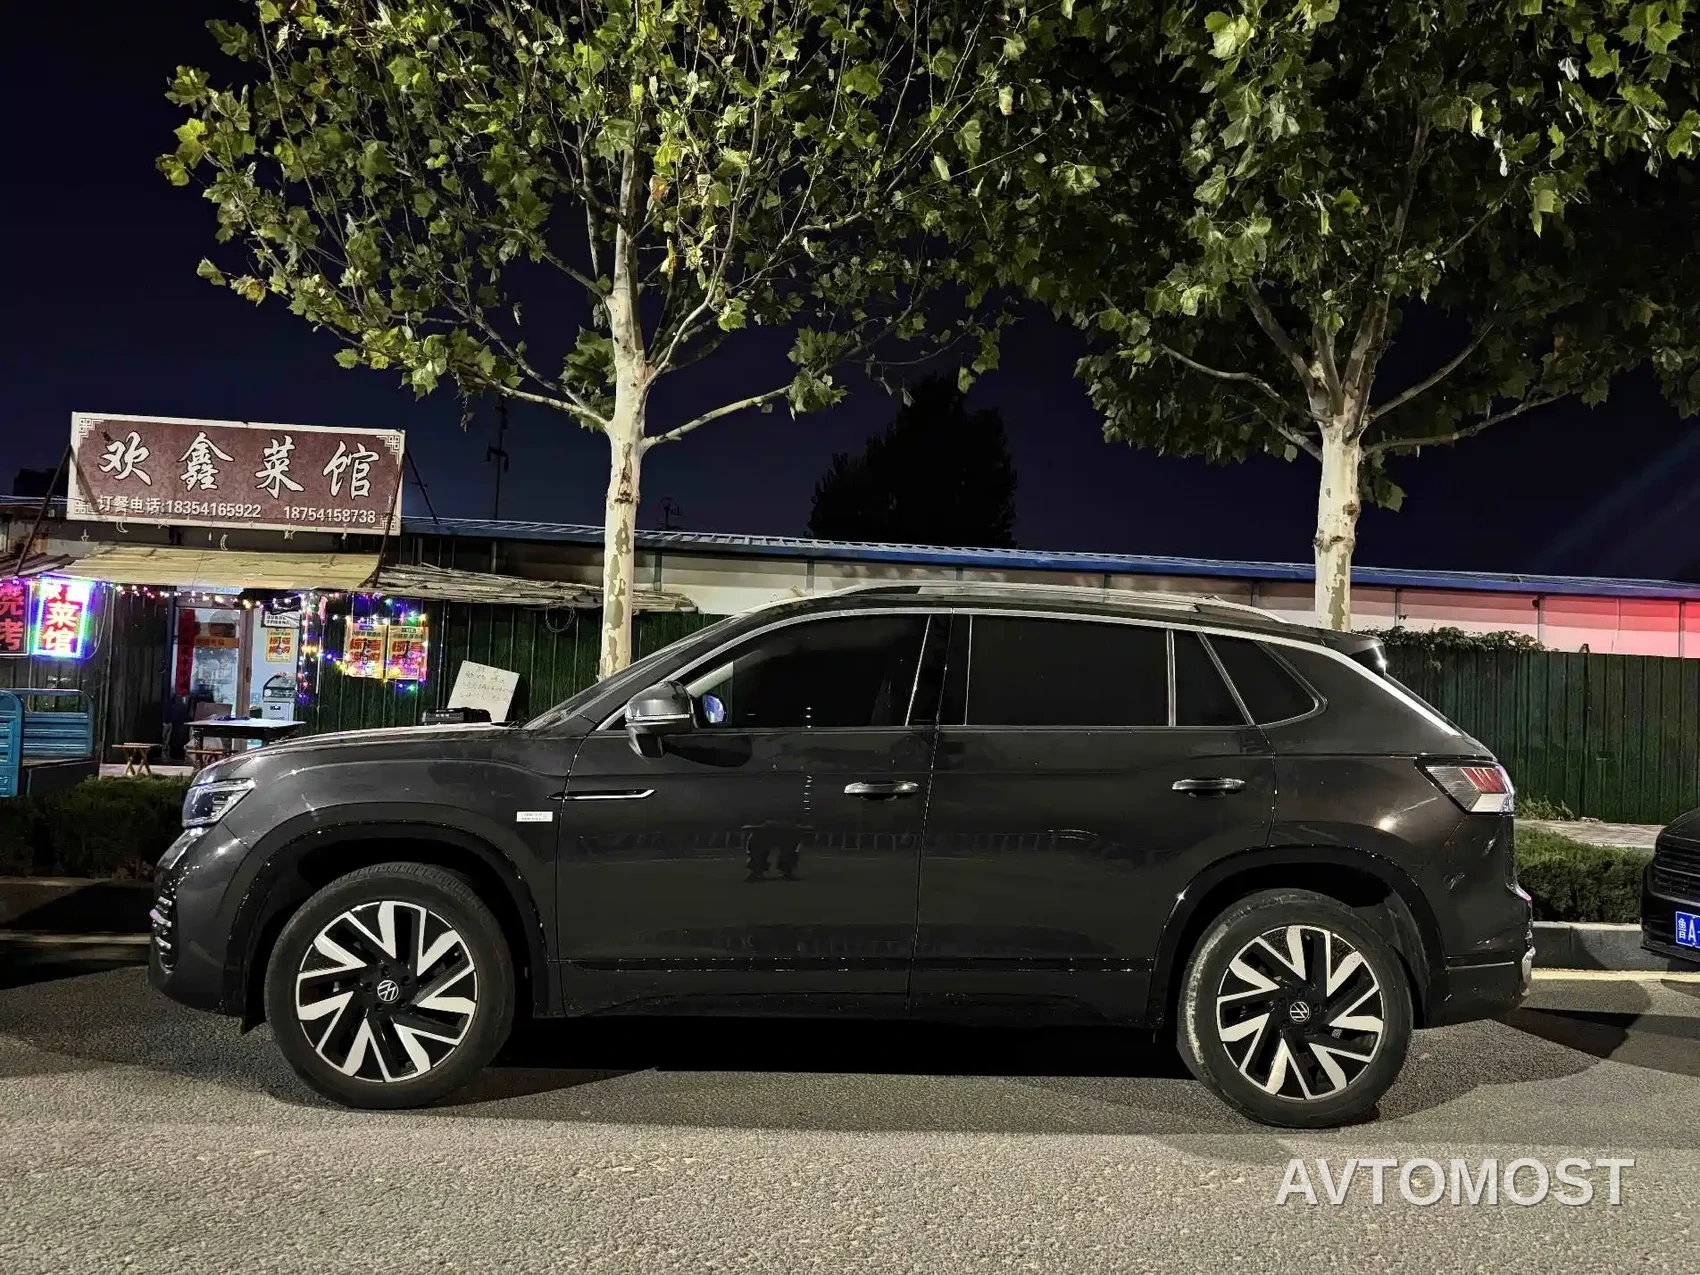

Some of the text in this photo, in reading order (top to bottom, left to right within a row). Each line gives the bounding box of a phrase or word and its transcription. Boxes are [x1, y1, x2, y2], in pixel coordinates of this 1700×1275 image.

[98, 431, 381, 500] 欢鑫菜馆
[283, 506, 377, 524] 18754158738
